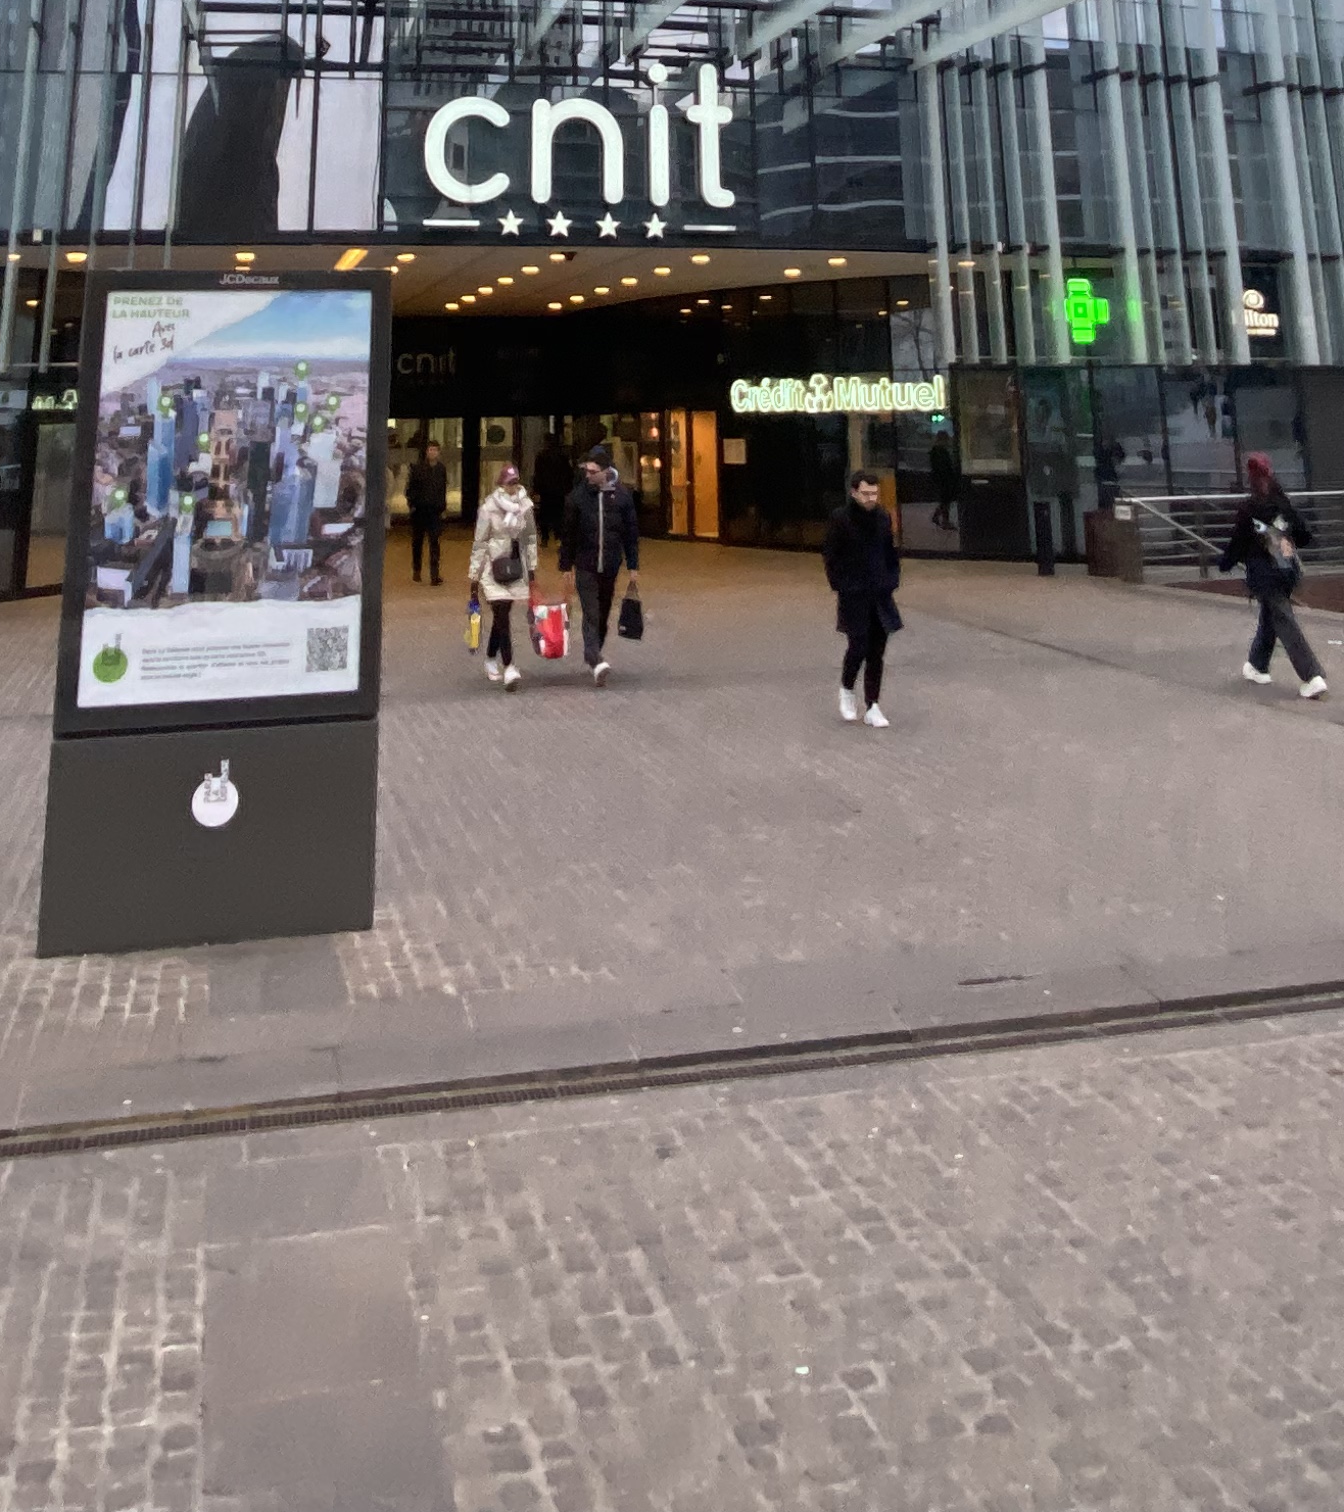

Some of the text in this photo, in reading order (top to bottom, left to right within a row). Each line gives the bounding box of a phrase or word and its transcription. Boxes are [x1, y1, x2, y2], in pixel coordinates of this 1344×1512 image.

[424, 63, 736, 208] cnit
[219, 273, 280, 285] JCDecaux
[113, 295, 183, 306] PRENEZ DE
[112, 308, 190, 319] LA HAUTEUR
[730, 374, 945, 413] Crédit Mutuel
